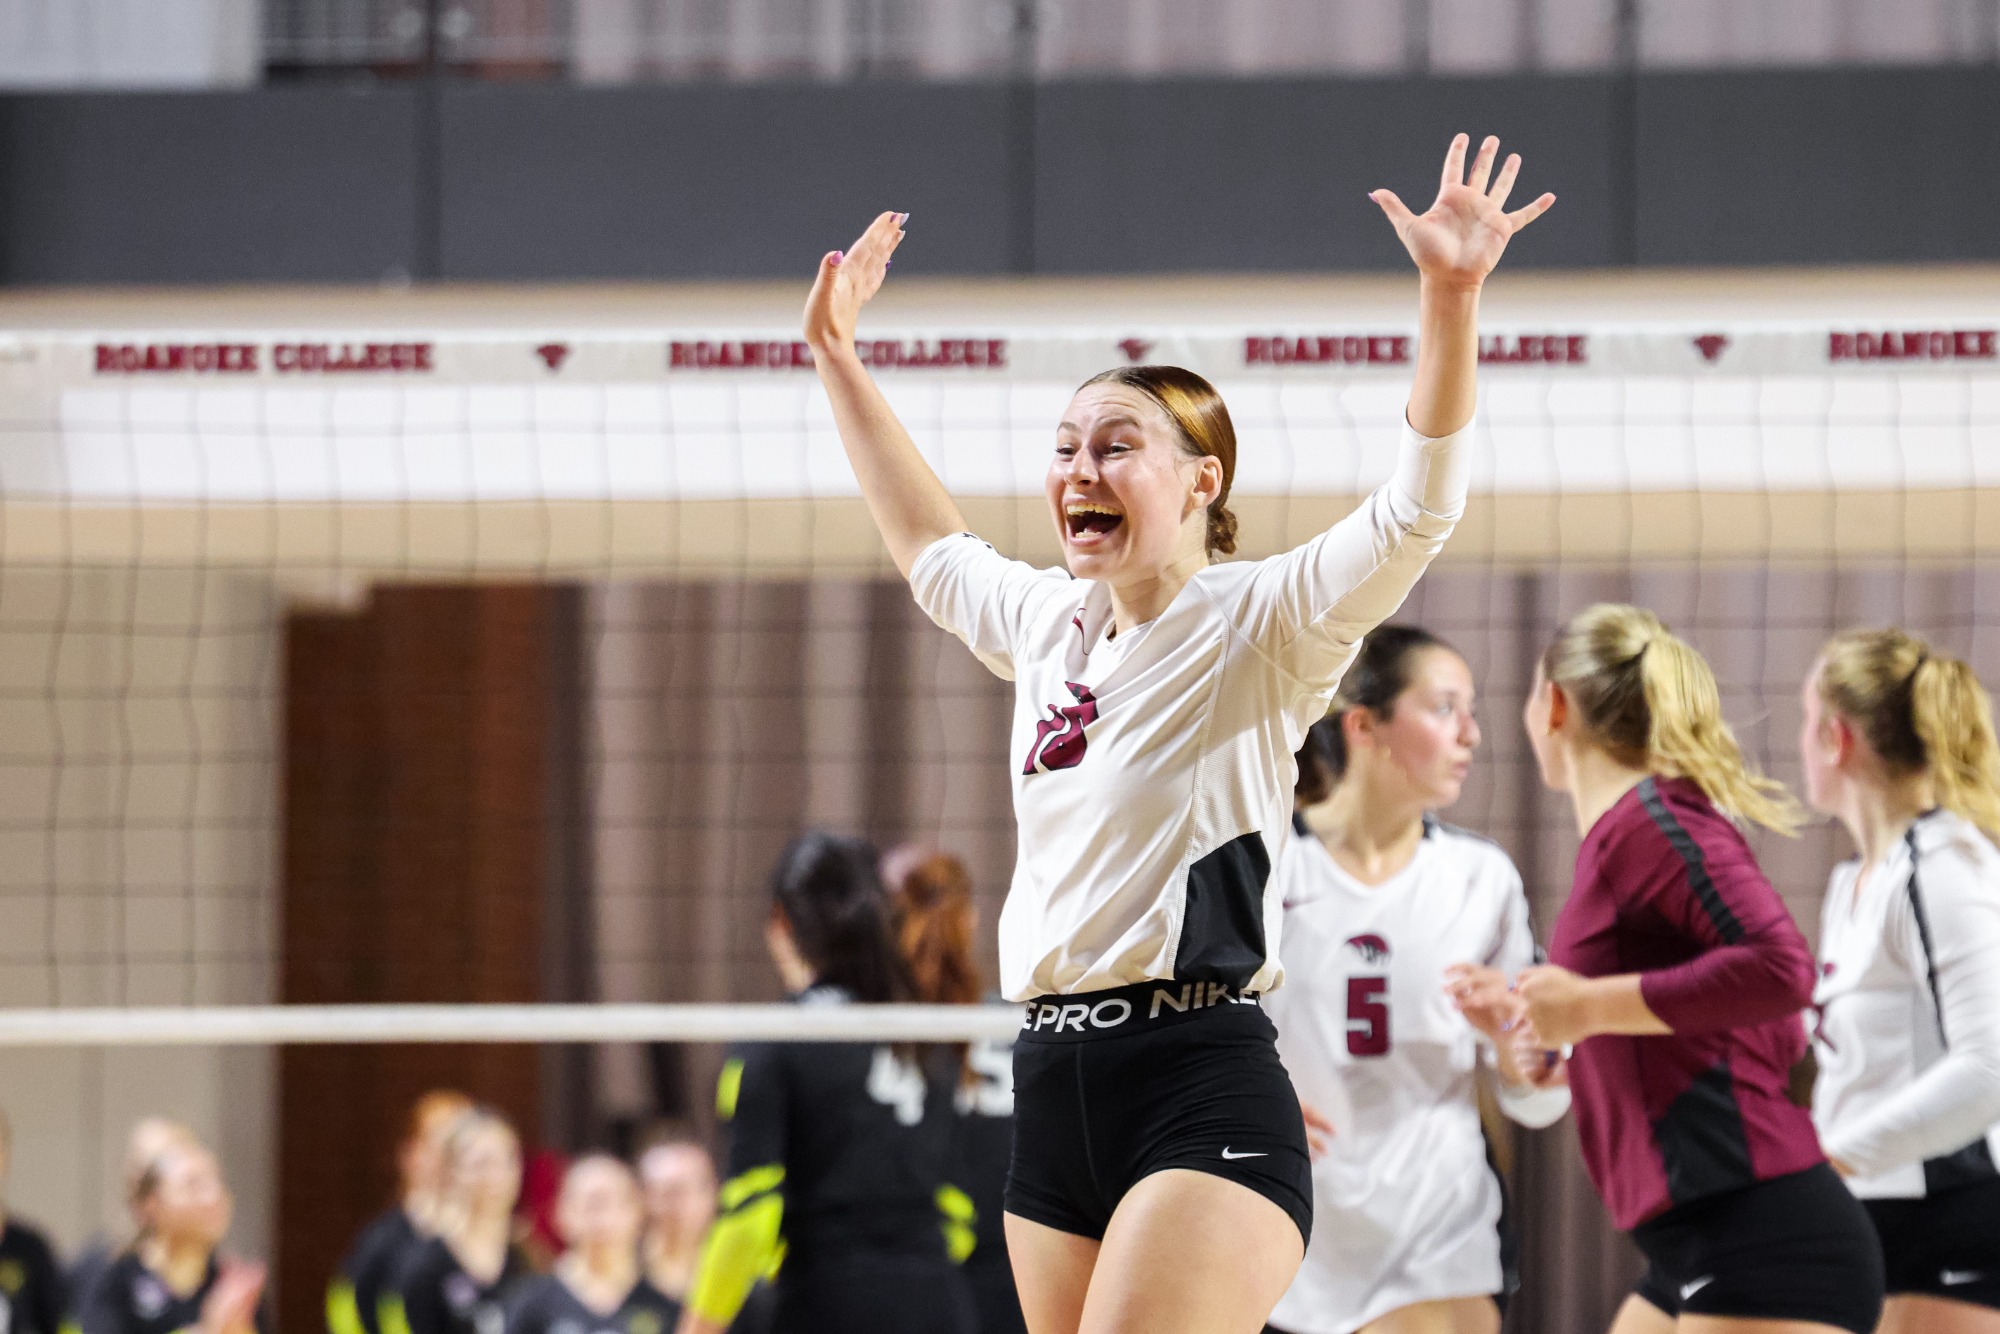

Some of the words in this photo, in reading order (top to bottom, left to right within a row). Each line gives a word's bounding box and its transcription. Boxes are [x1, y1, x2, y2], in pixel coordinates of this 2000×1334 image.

[95, 342, 259, 373] ROANOKE
[274, 341, 435, 373] COLLEGE
[669, 340, 816, 370] ROANOK
[1244, 334, 1409, 365] ROANOKE
[1477, 334, 1587, 364] LLEGE
[1828, 330, 1998, 362] ROANOKE
[1346, 976, 1391, 1057] 5
[865, 1044, 927, 1127] 4
